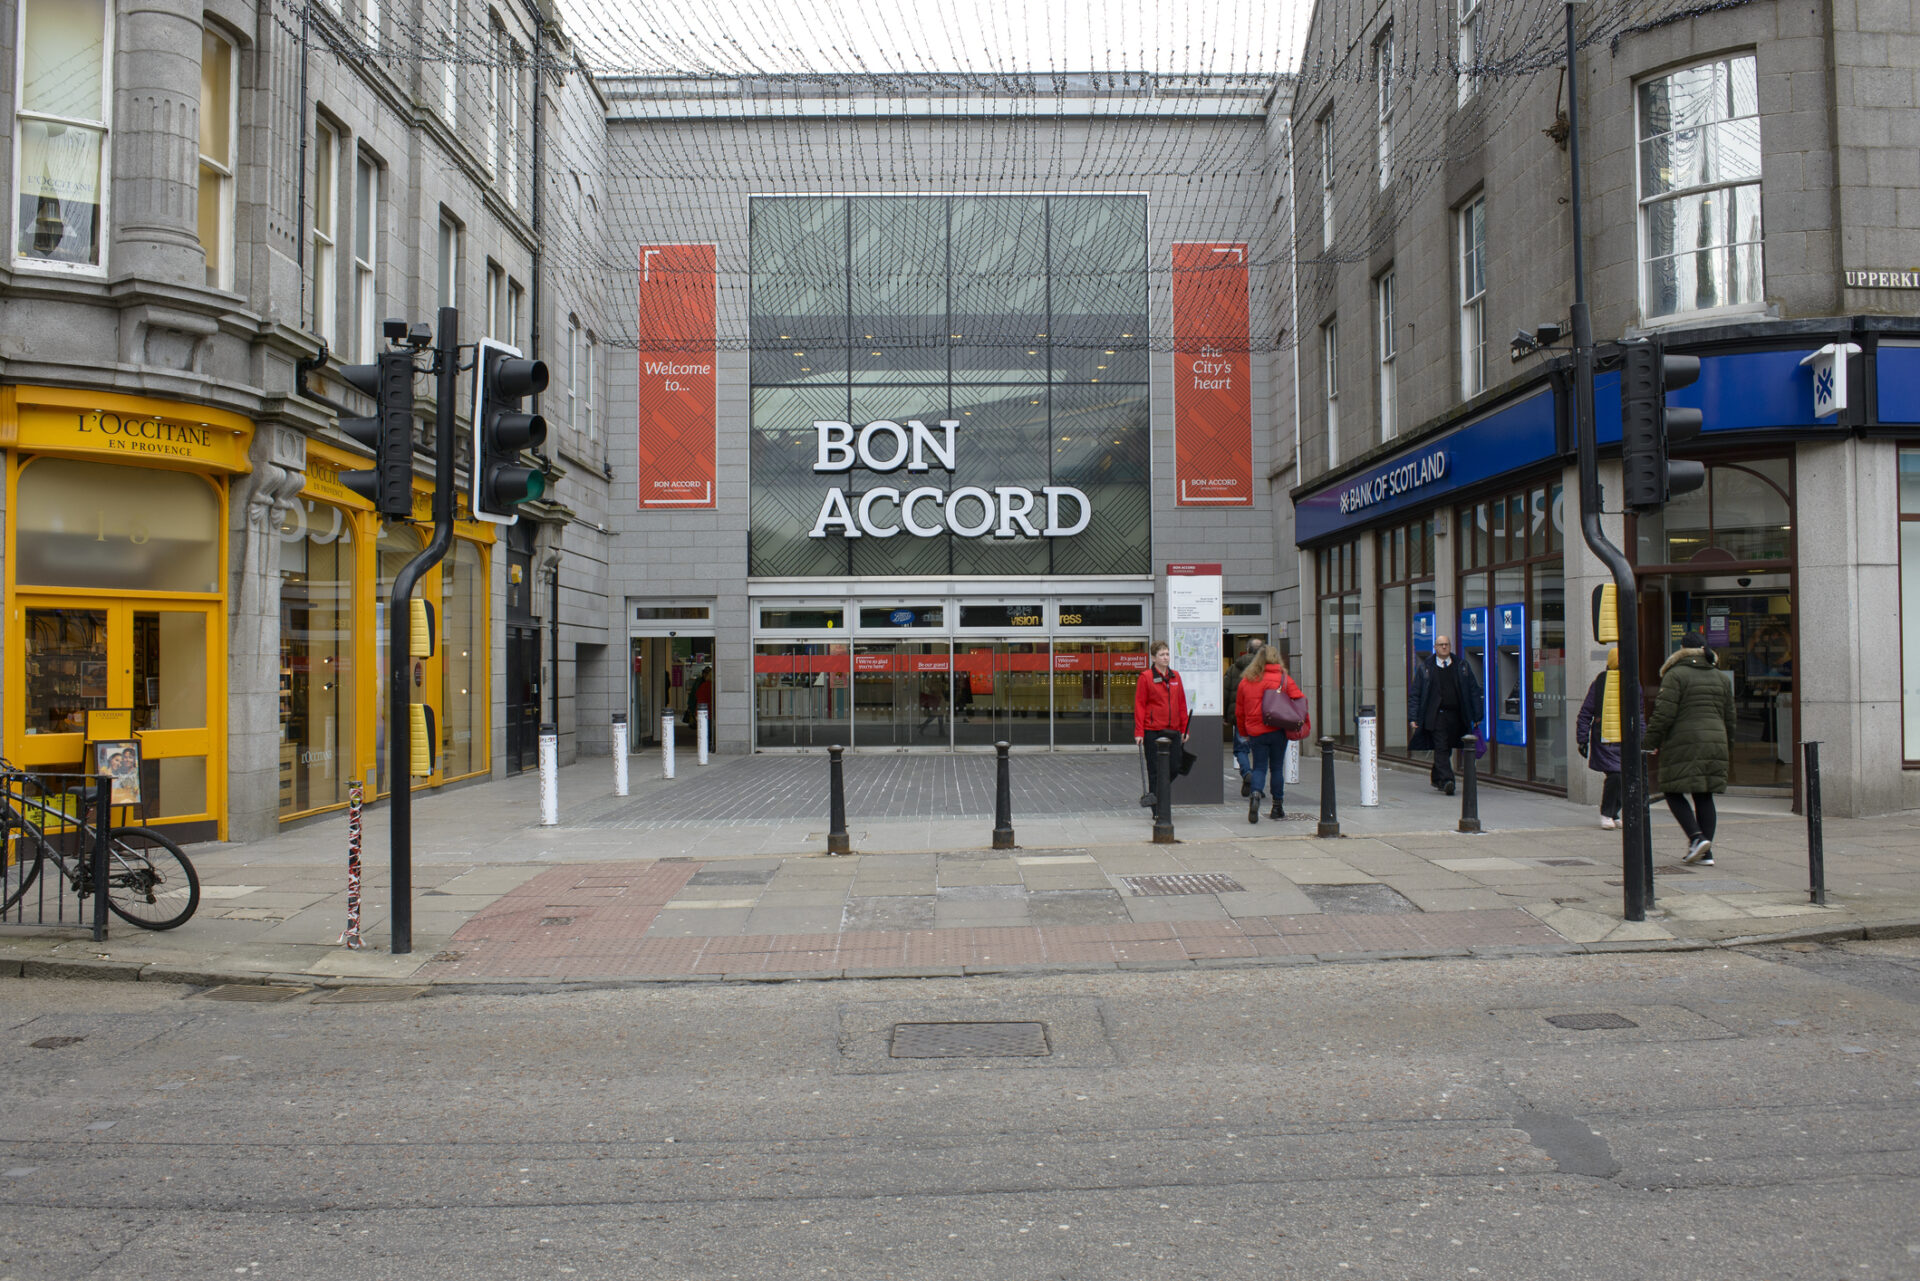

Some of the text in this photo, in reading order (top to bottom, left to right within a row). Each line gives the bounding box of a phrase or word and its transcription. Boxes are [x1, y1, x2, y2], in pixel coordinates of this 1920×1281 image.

[1845, 271, 1919, 288] UPPERKI
[1201, 344, 1224, 358] the
[644, 361, 711, 375] Welcome
[1192, 360, 1232, 376] City's
[665, 379, 690, 392] to...
[1193, 376, 1232, 390] heart
[77, 412, 211, 447] L'OCCITANE
[109, 439, 192, 457] EN PROVENCE
[812, 420, 960, 473] BON
[1350, 451, 1446, 512] BANK OF SCOTLAND
[808, 486, 1092, 538] ACCORD
[1011, 613, 1039, 626] vision
